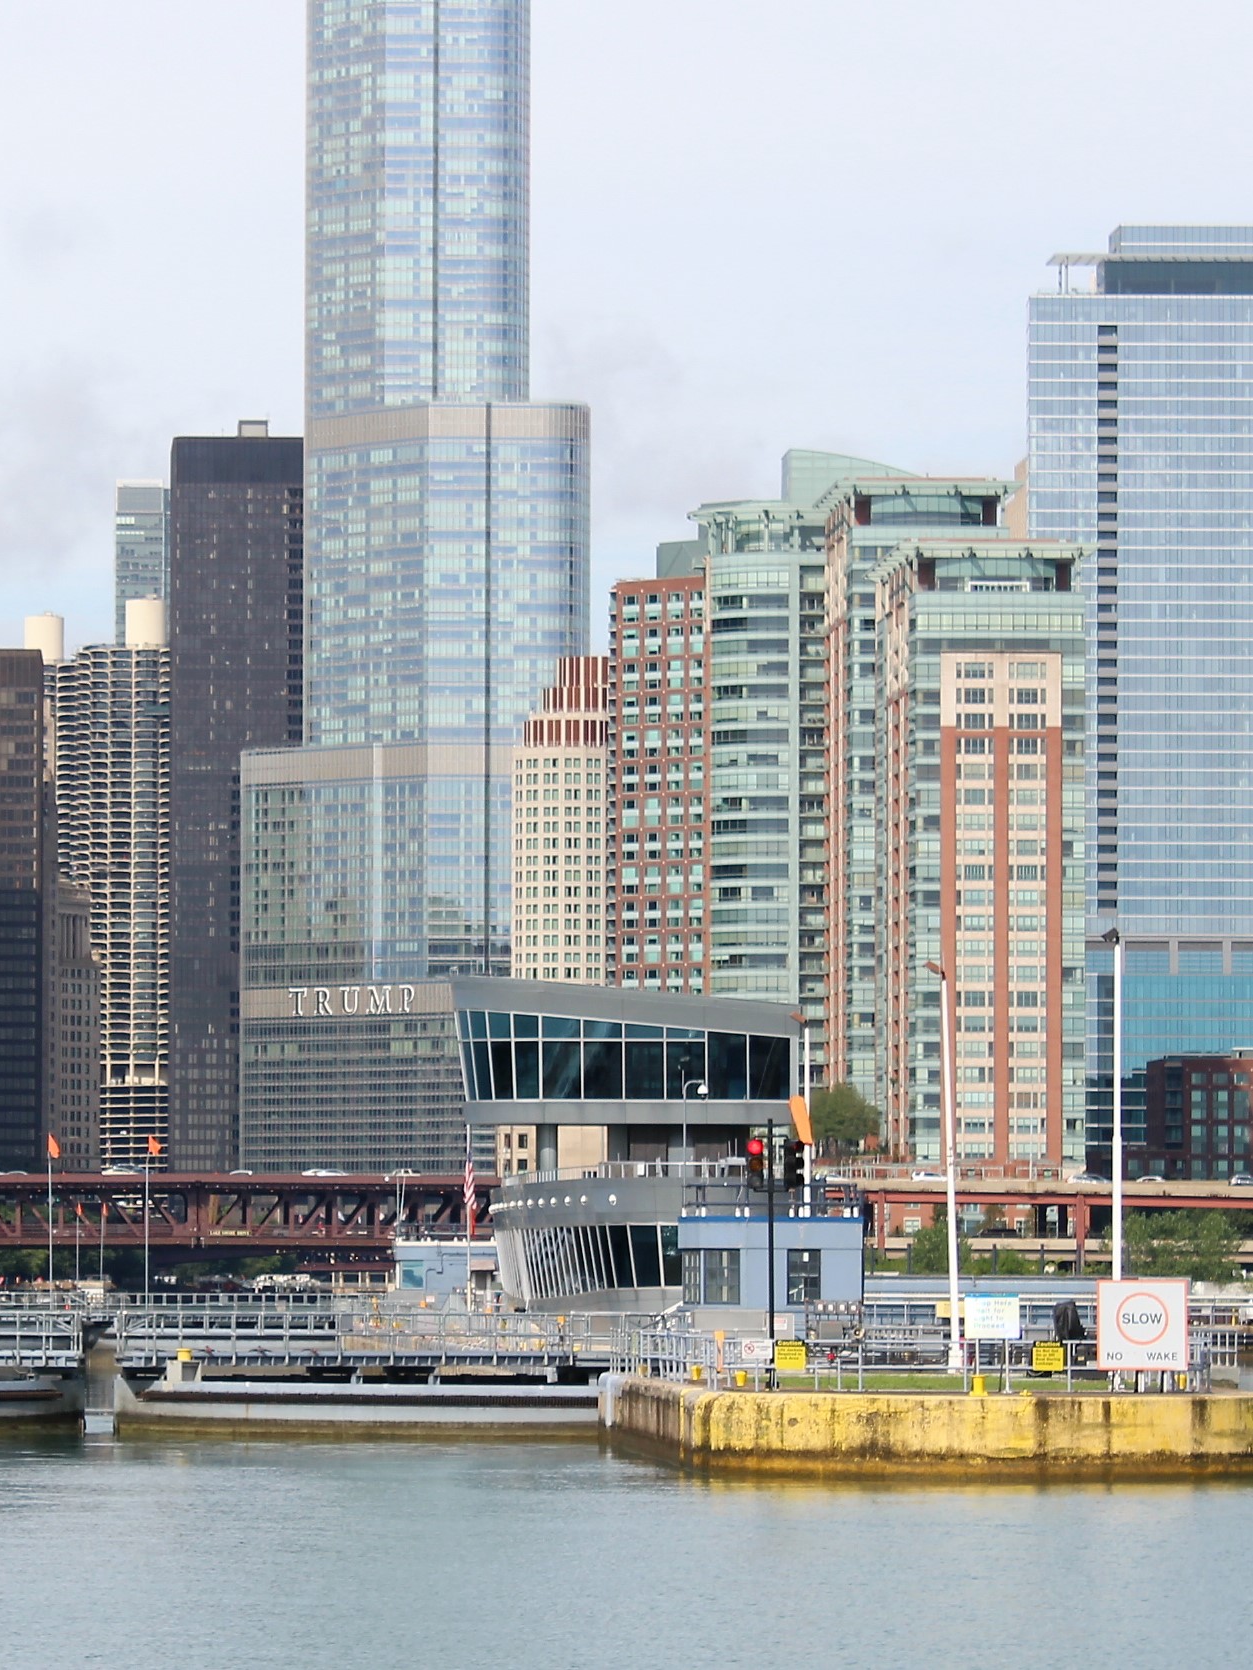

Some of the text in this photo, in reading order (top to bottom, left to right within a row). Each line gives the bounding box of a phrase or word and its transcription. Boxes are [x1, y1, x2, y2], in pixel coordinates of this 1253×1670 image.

[288, 984, 415, 1017] TRUMP
[1122, 1313, 1163, 1325] SLOW
[1107, 1352, 1178, 1361] NO WAKE
